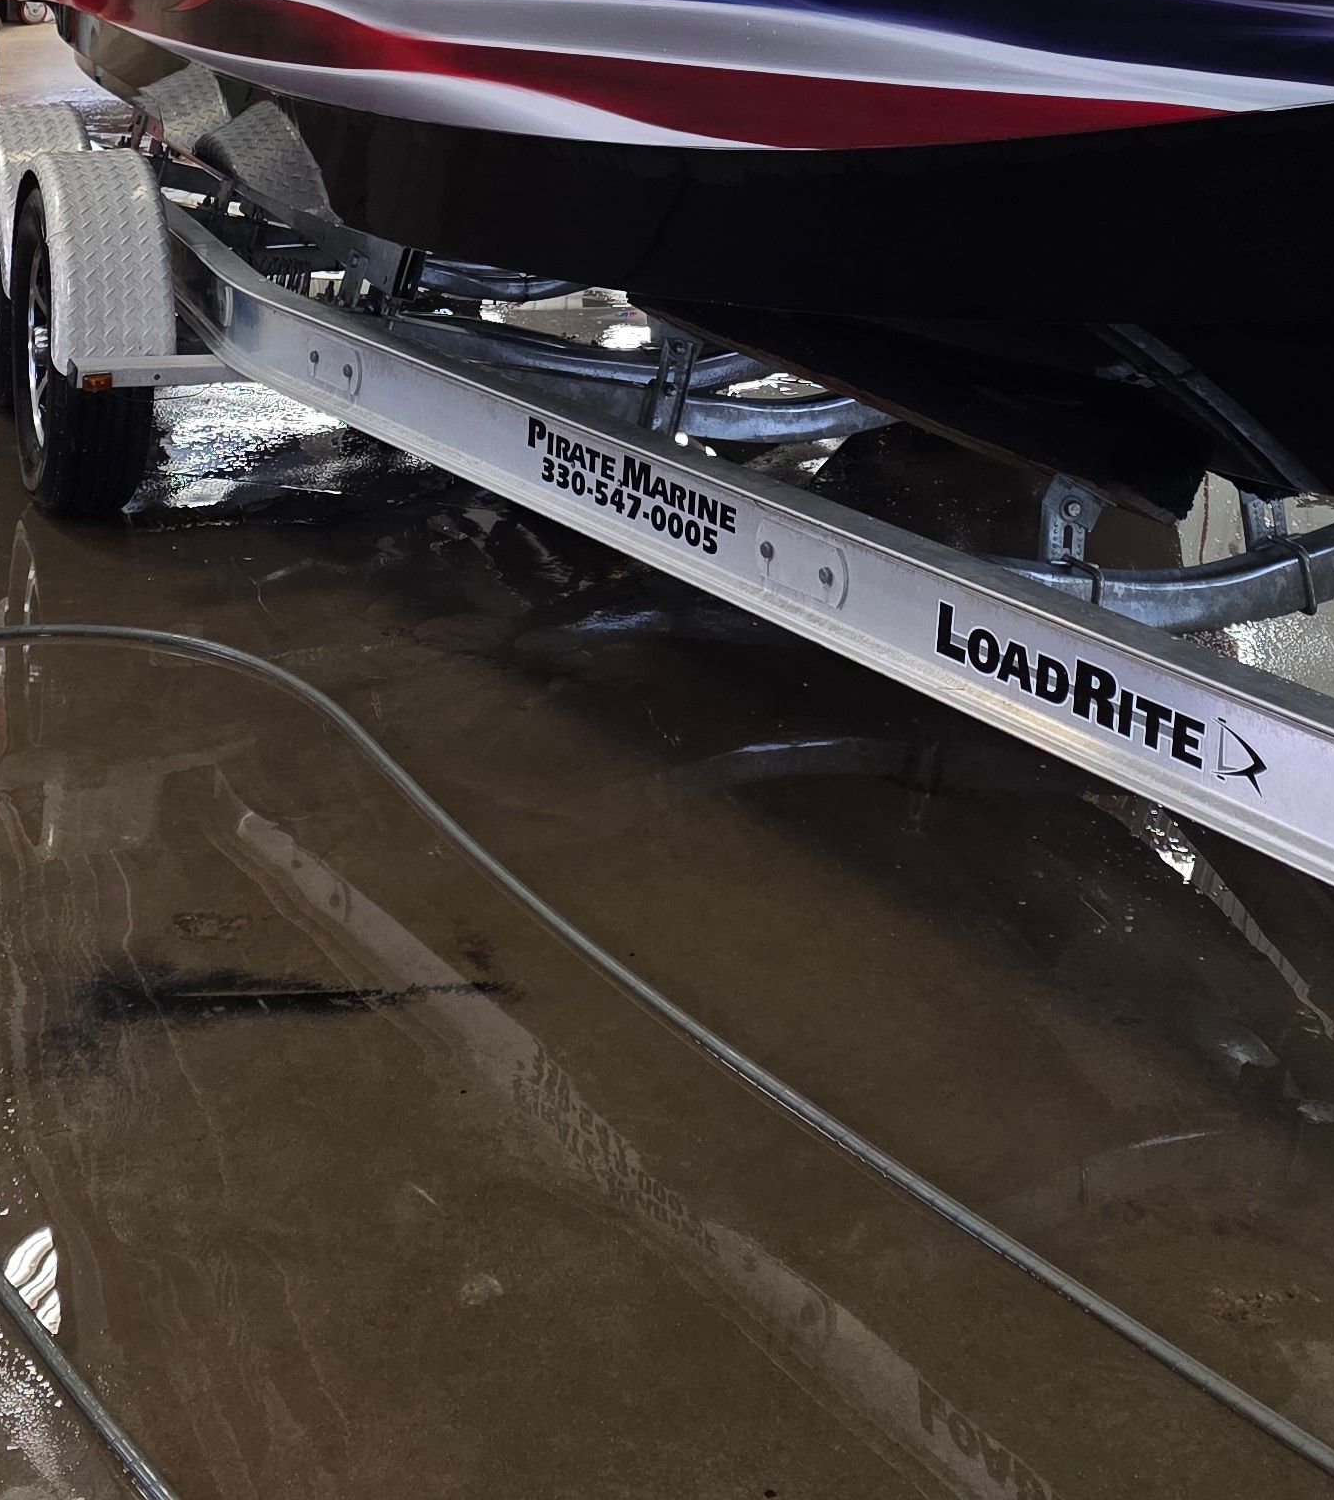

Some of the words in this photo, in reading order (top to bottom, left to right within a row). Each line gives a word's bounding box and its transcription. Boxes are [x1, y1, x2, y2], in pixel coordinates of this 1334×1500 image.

[528, 416, 617, 481] PIRATE
[622, 455, 737, 534] MARINE
[541, 457, 718, 555] 330-547-0005
